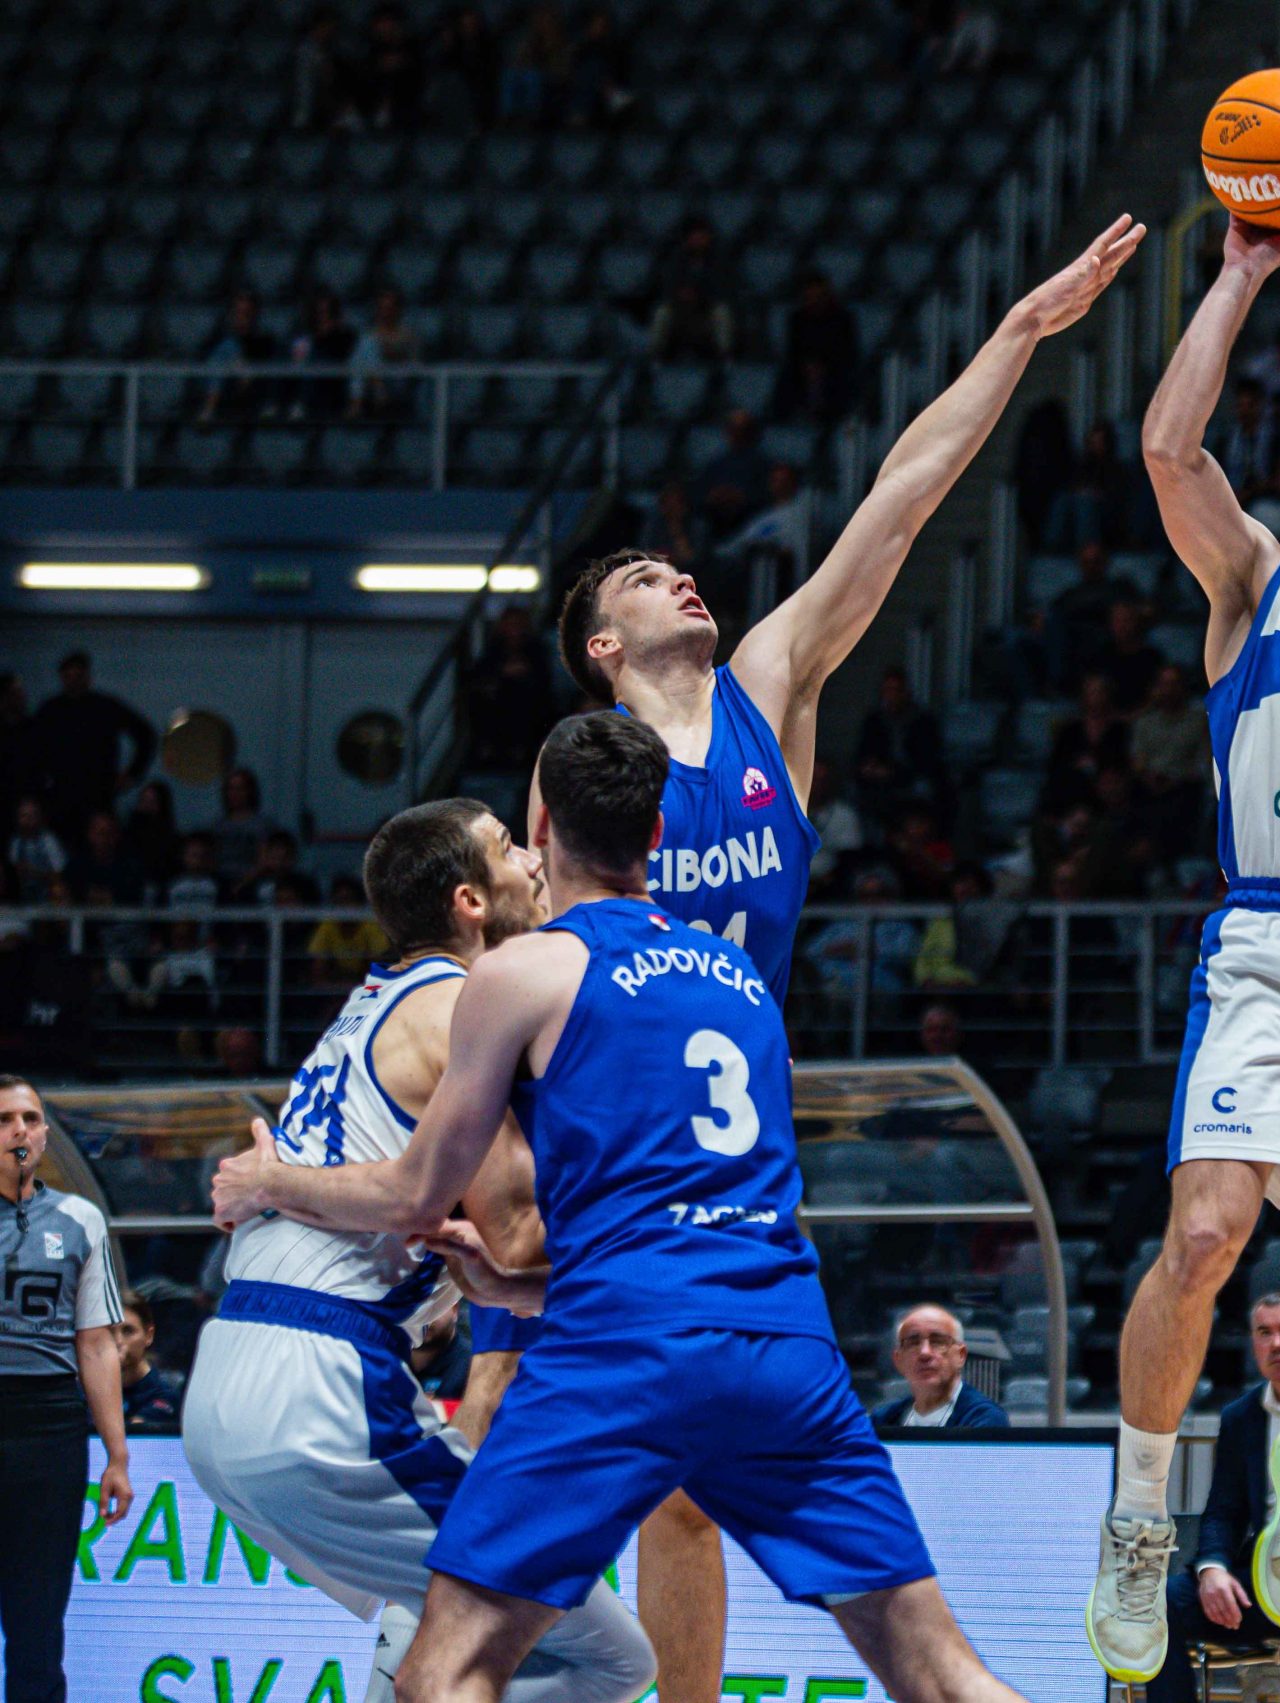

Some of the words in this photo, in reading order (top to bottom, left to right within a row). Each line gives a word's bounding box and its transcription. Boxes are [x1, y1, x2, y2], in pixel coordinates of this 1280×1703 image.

[646, 825, 783, 892] CIBONA
[683, 1027, 761, 1157] 3
[1193, 1122, 1253, 1135] cromaris
